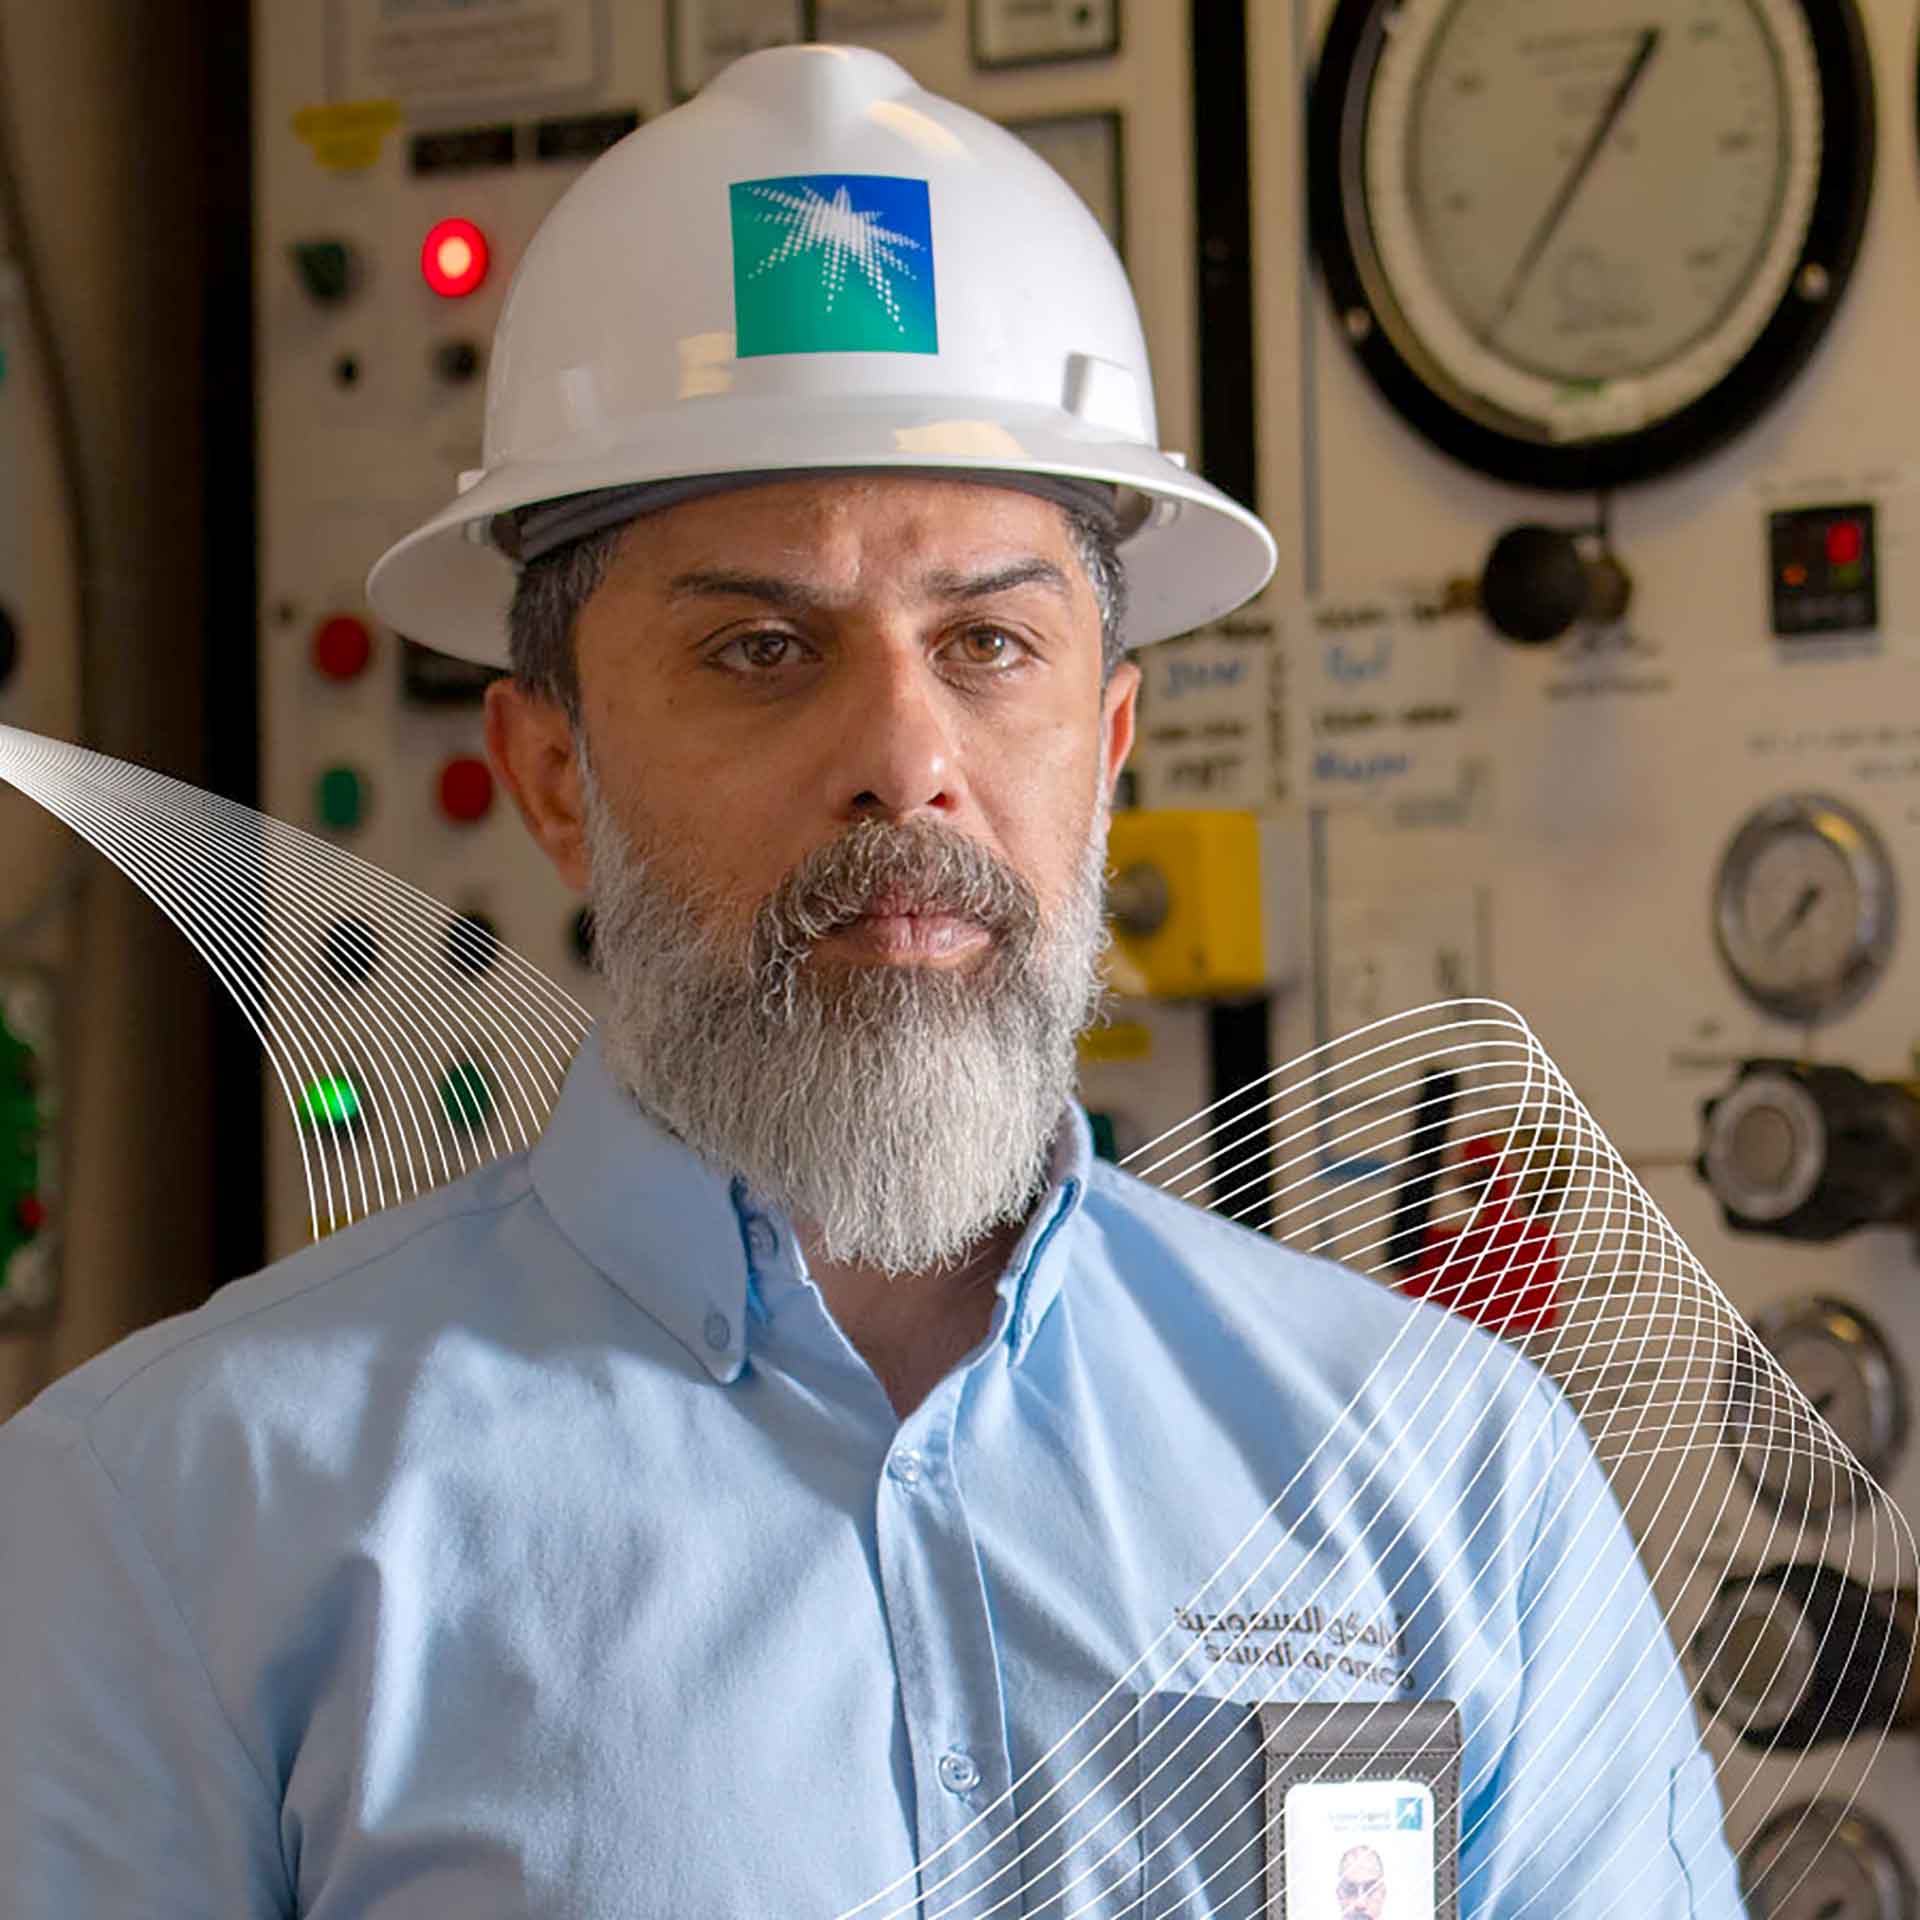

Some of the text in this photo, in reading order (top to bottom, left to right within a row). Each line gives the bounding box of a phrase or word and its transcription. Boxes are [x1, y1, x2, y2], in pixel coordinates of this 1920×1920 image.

[1175, 1606, 1407, 1657] أرامكو السعودية
[1205, 1641, 1416, 1690] saudi aramco
